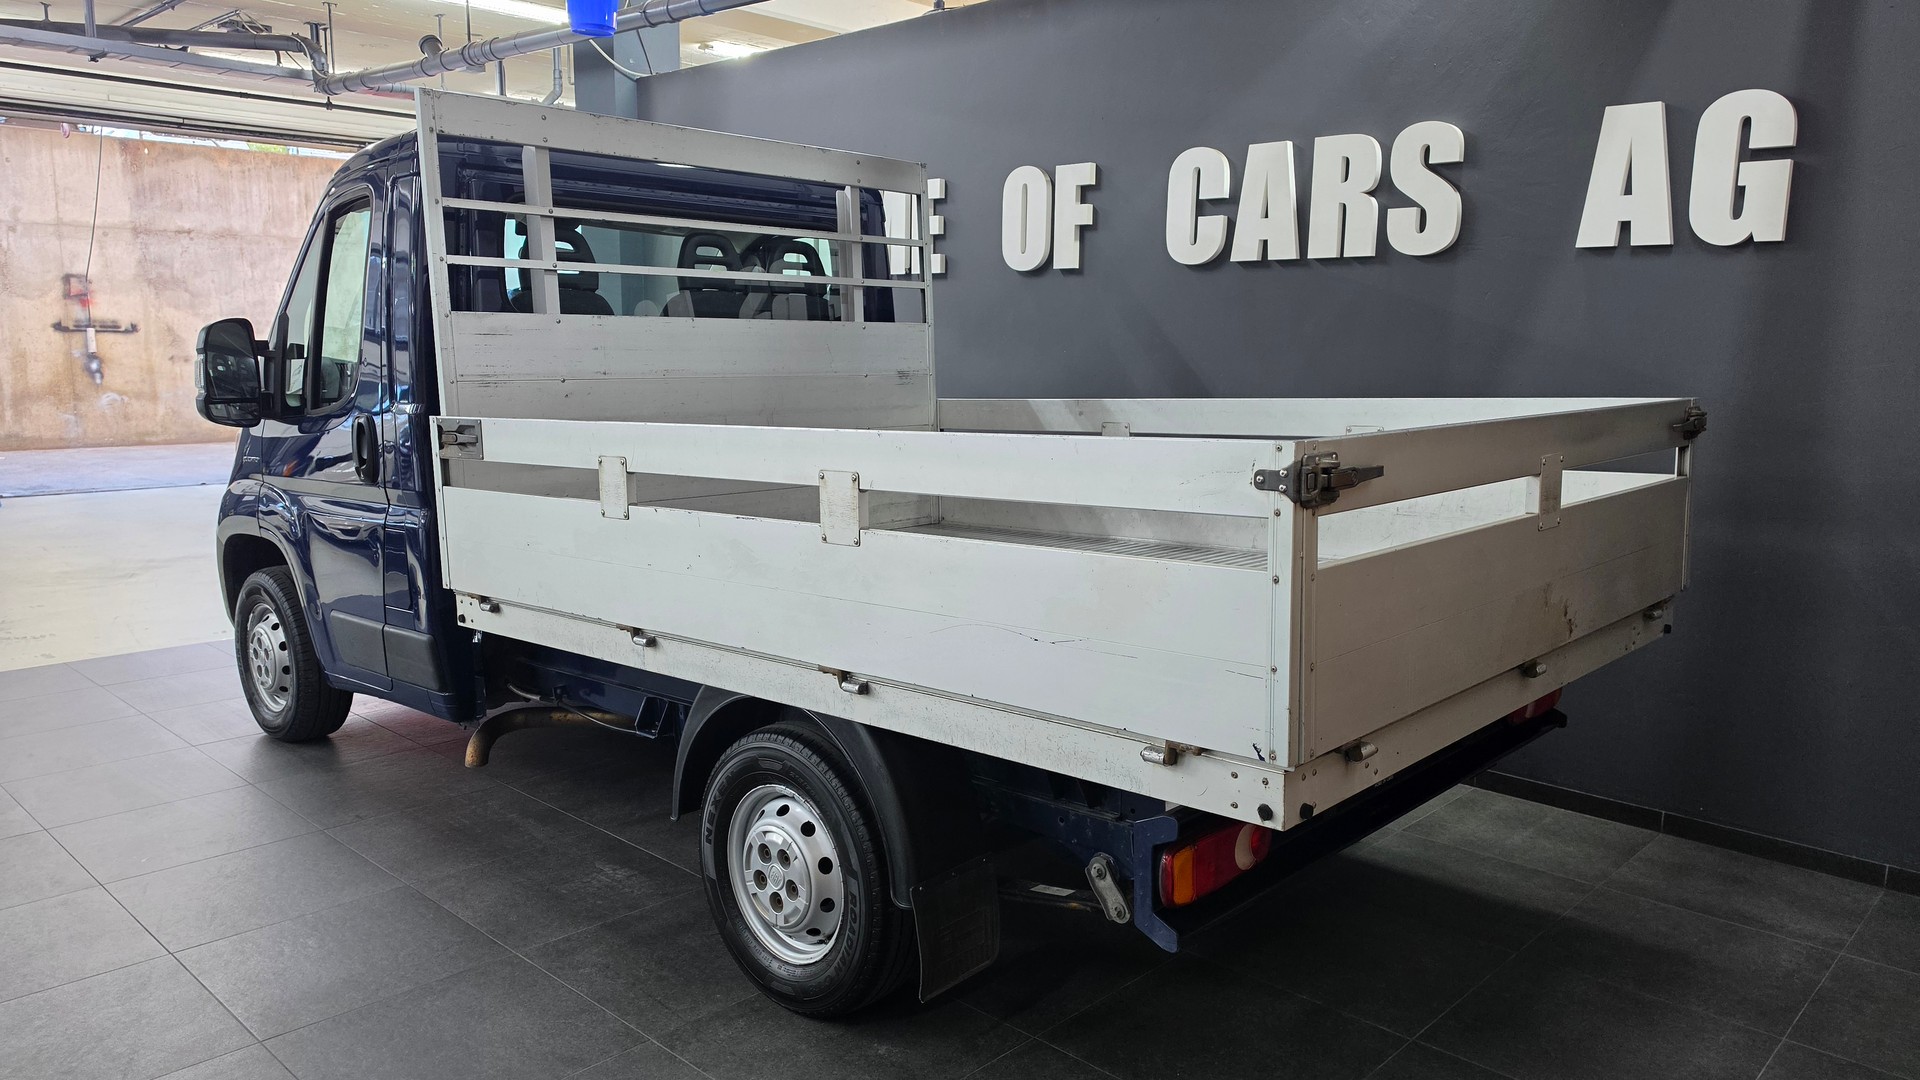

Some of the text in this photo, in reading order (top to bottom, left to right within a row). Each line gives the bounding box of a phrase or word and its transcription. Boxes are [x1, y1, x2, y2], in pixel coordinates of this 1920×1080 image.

[1001, 162, 1097, 272] OF
[1165, 120, 1466, 266] CARS
[1575, 88, 1799, 249] AG
